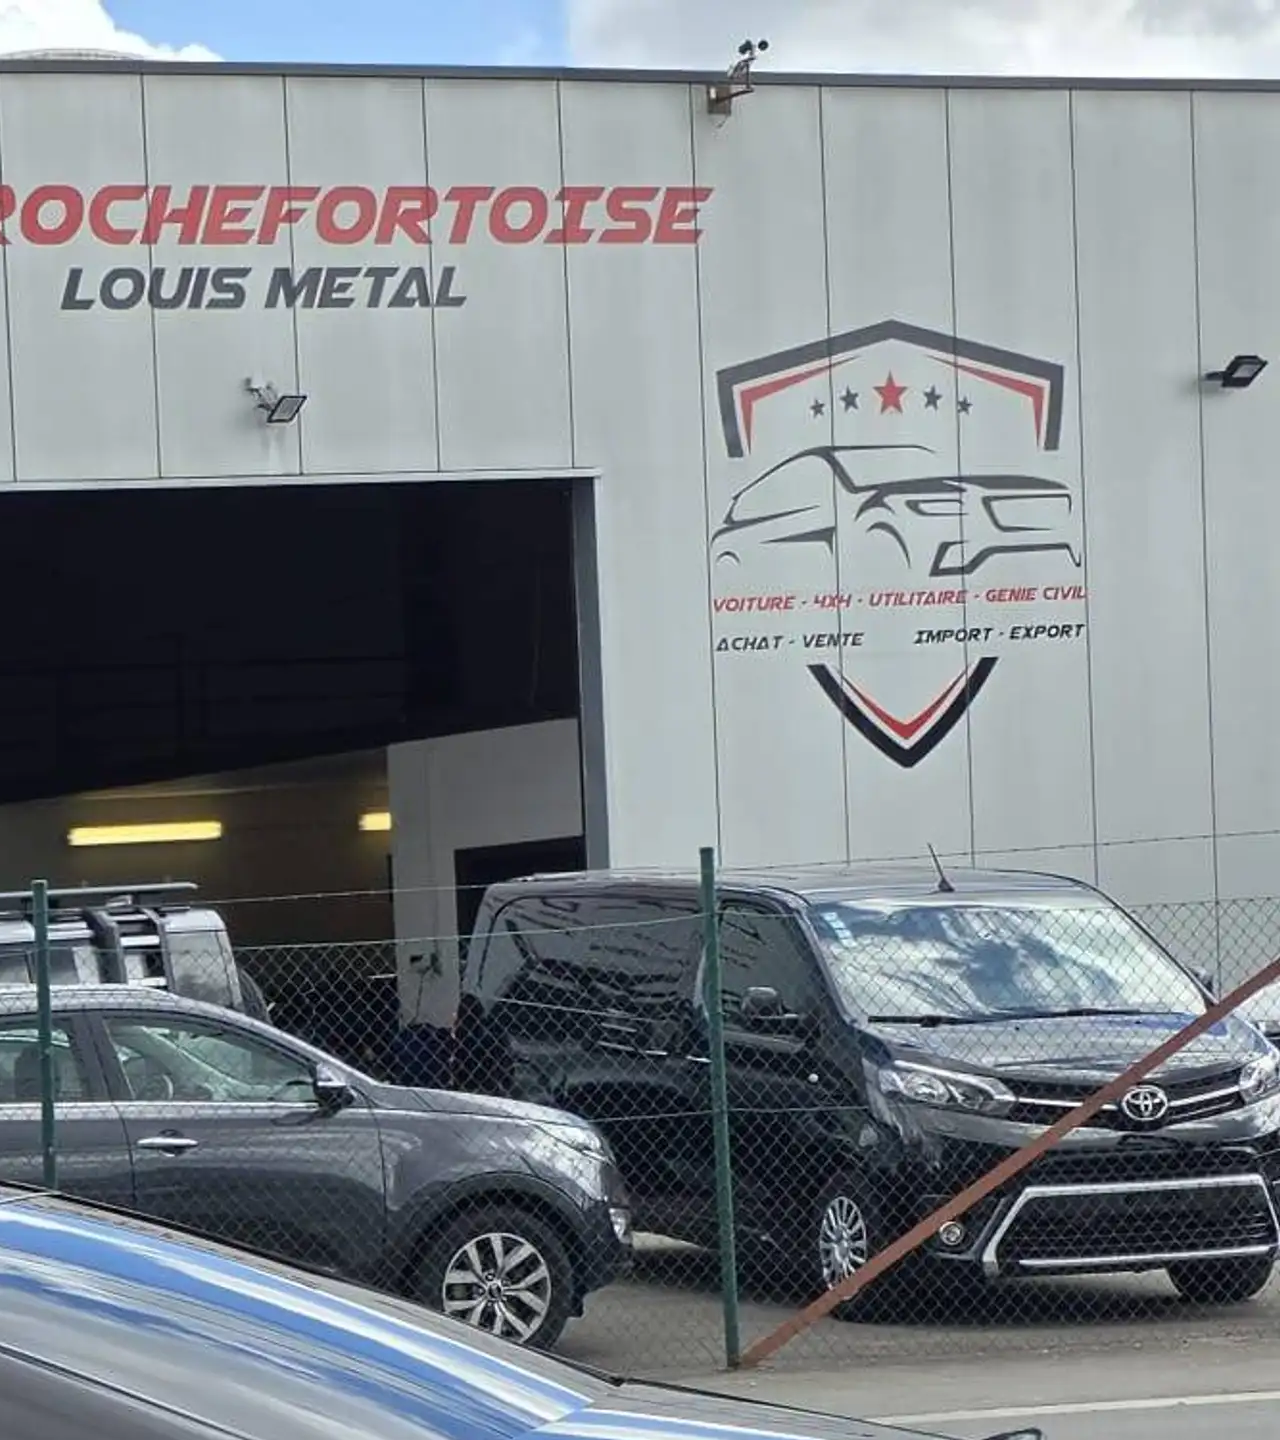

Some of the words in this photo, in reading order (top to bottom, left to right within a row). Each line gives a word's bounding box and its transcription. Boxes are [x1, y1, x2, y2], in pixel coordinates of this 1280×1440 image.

[61, 266, 252, 311] LOUIS
[264, 266, 468, 310] METAL
[713, 595, 796, 612] VOITURE
[813, 593, 852, 609] 4X4
[869, 589, 968, 607] UTILITAIRE
[985, 587, 1037, 603] GENIE
[1042, 585, 1087, 601] CIVIL
[715, 635, 784, 652] ACHAT
[802, 632, 865, 649] VENTE
[913, 627, 994, 645] IMPORT
[1008, 623, 1086, 641] EXPORT
